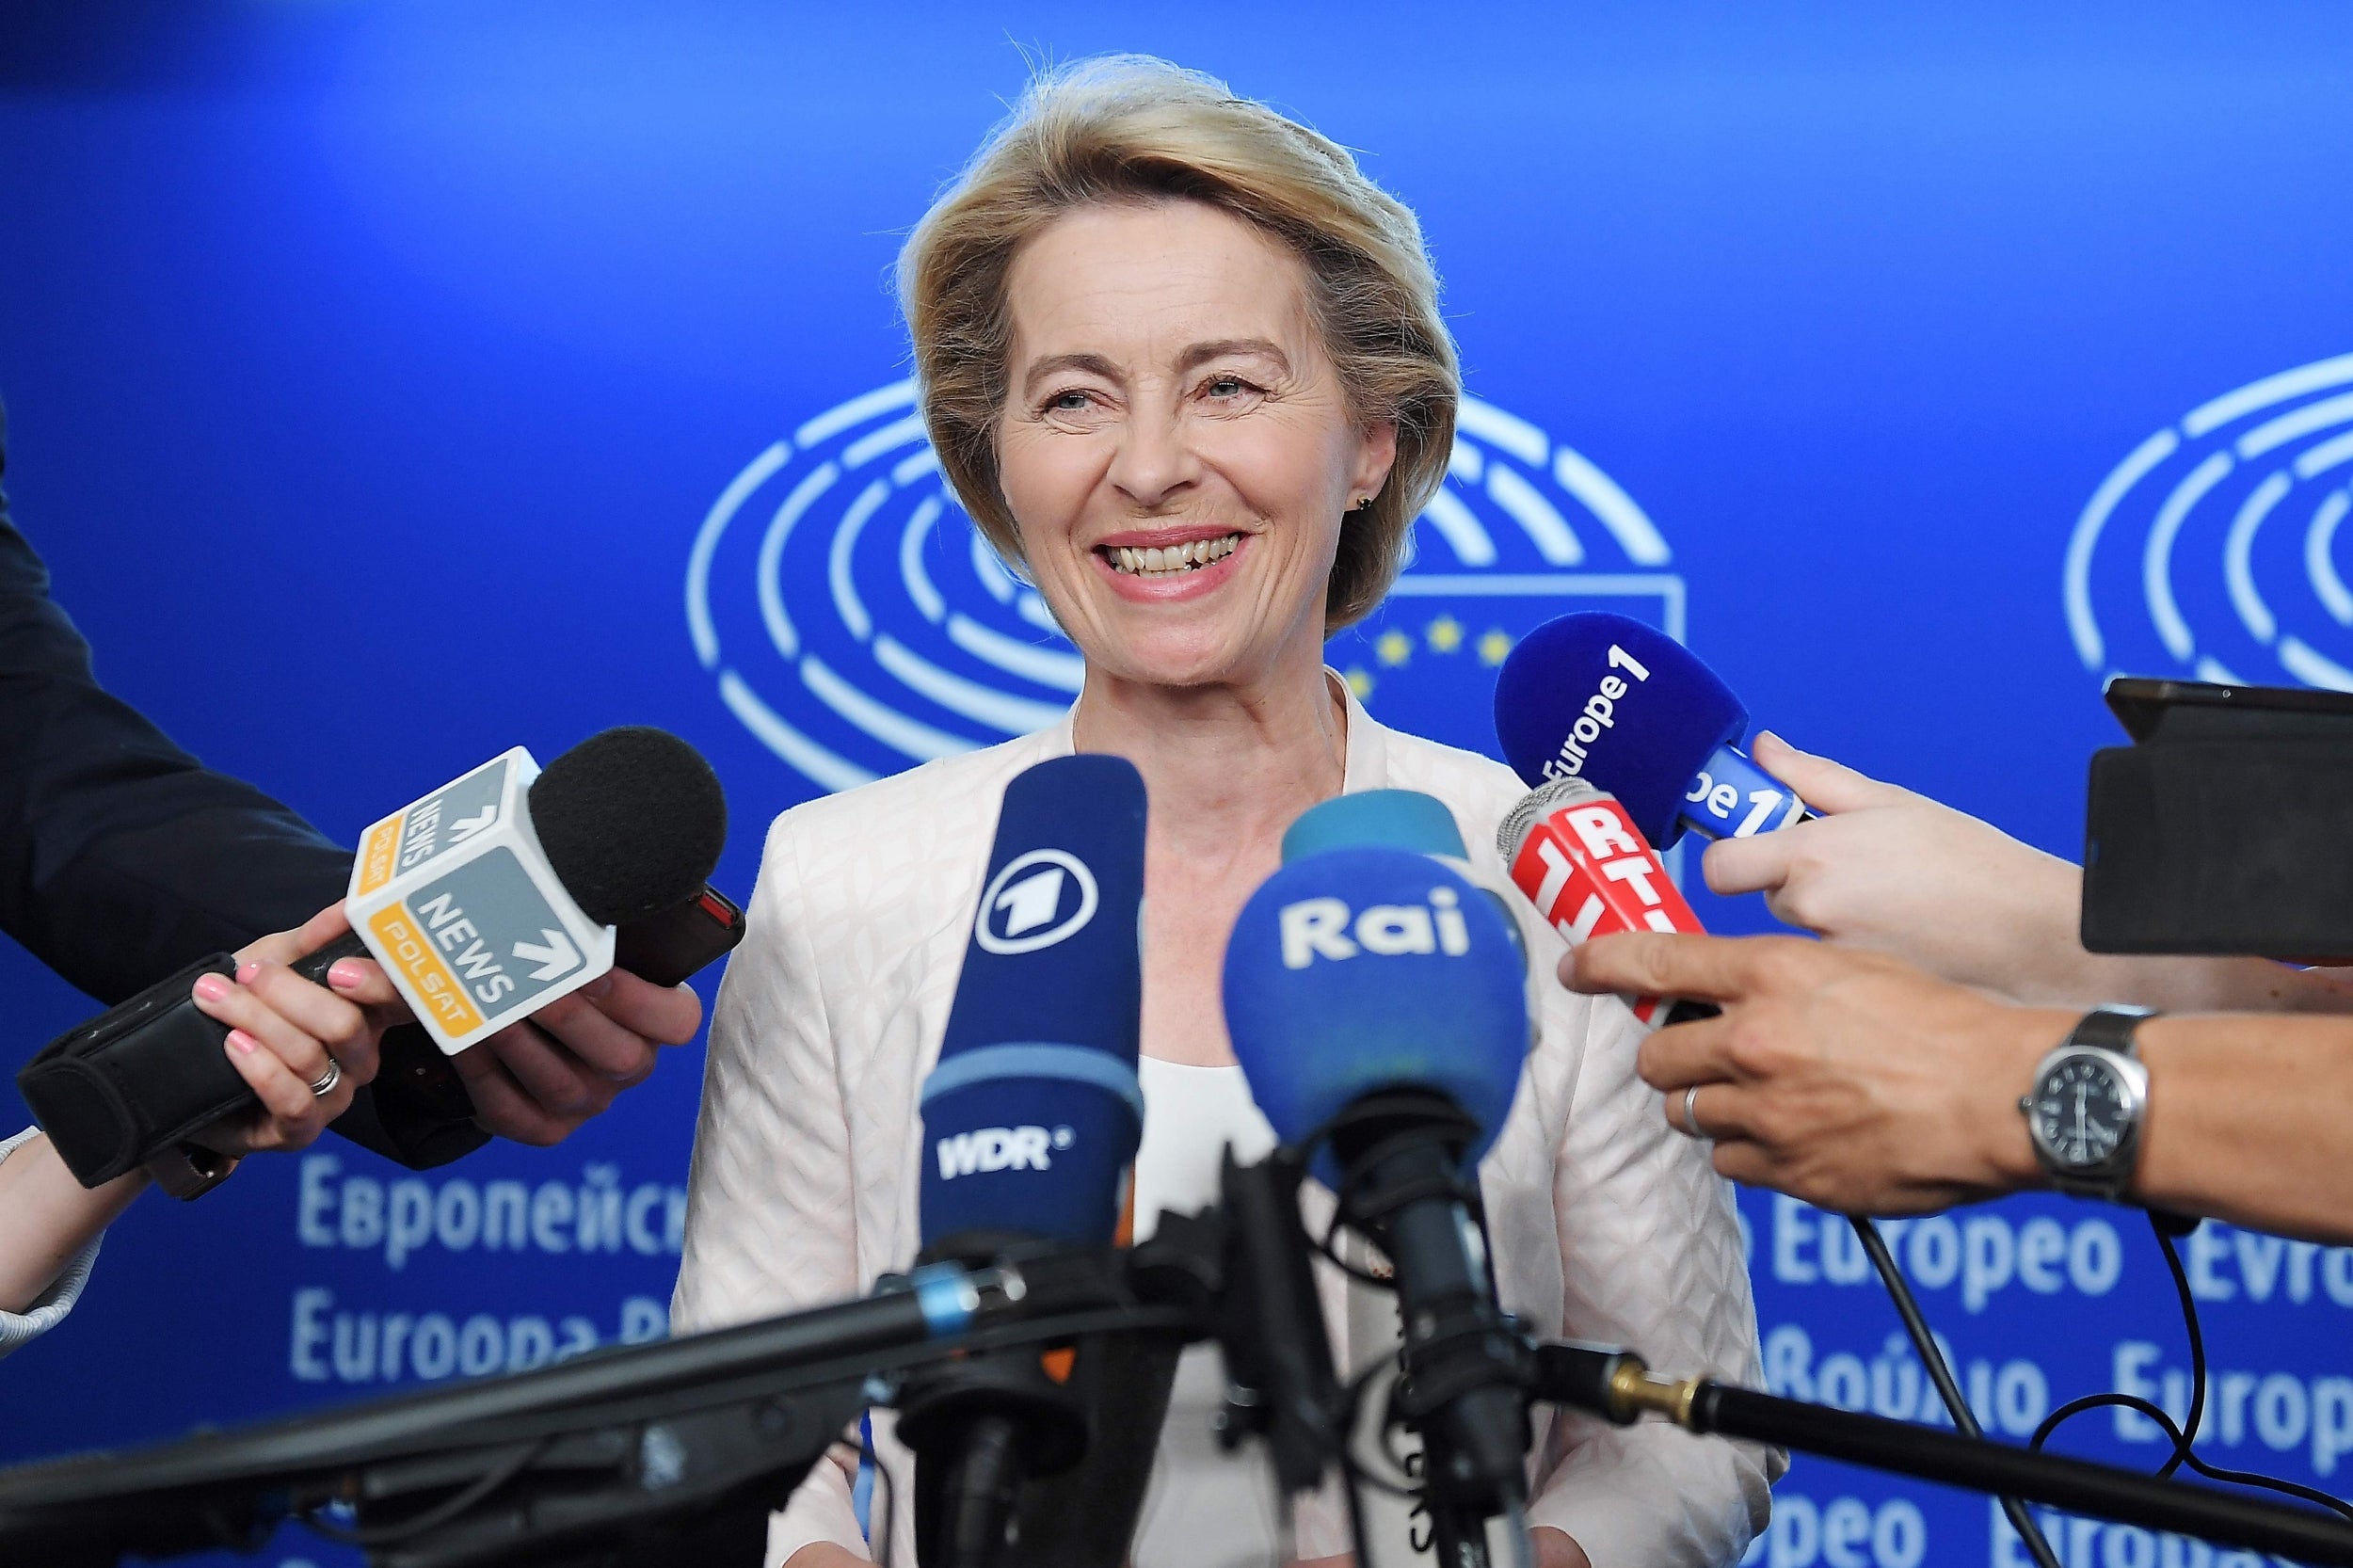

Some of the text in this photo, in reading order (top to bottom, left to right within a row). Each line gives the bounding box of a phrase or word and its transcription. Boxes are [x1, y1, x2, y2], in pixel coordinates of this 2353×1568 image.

[401, 799, 443, 867] NEWS
[382, 920, 468, 1020] POLSAT
[417, 893, 515, 1003] NEWS
[1279, 886, 1470, 969] Rai
[936, 1125, 1052, 1180] WDR
[1773, 1192, 2122, 1314] Europeo
